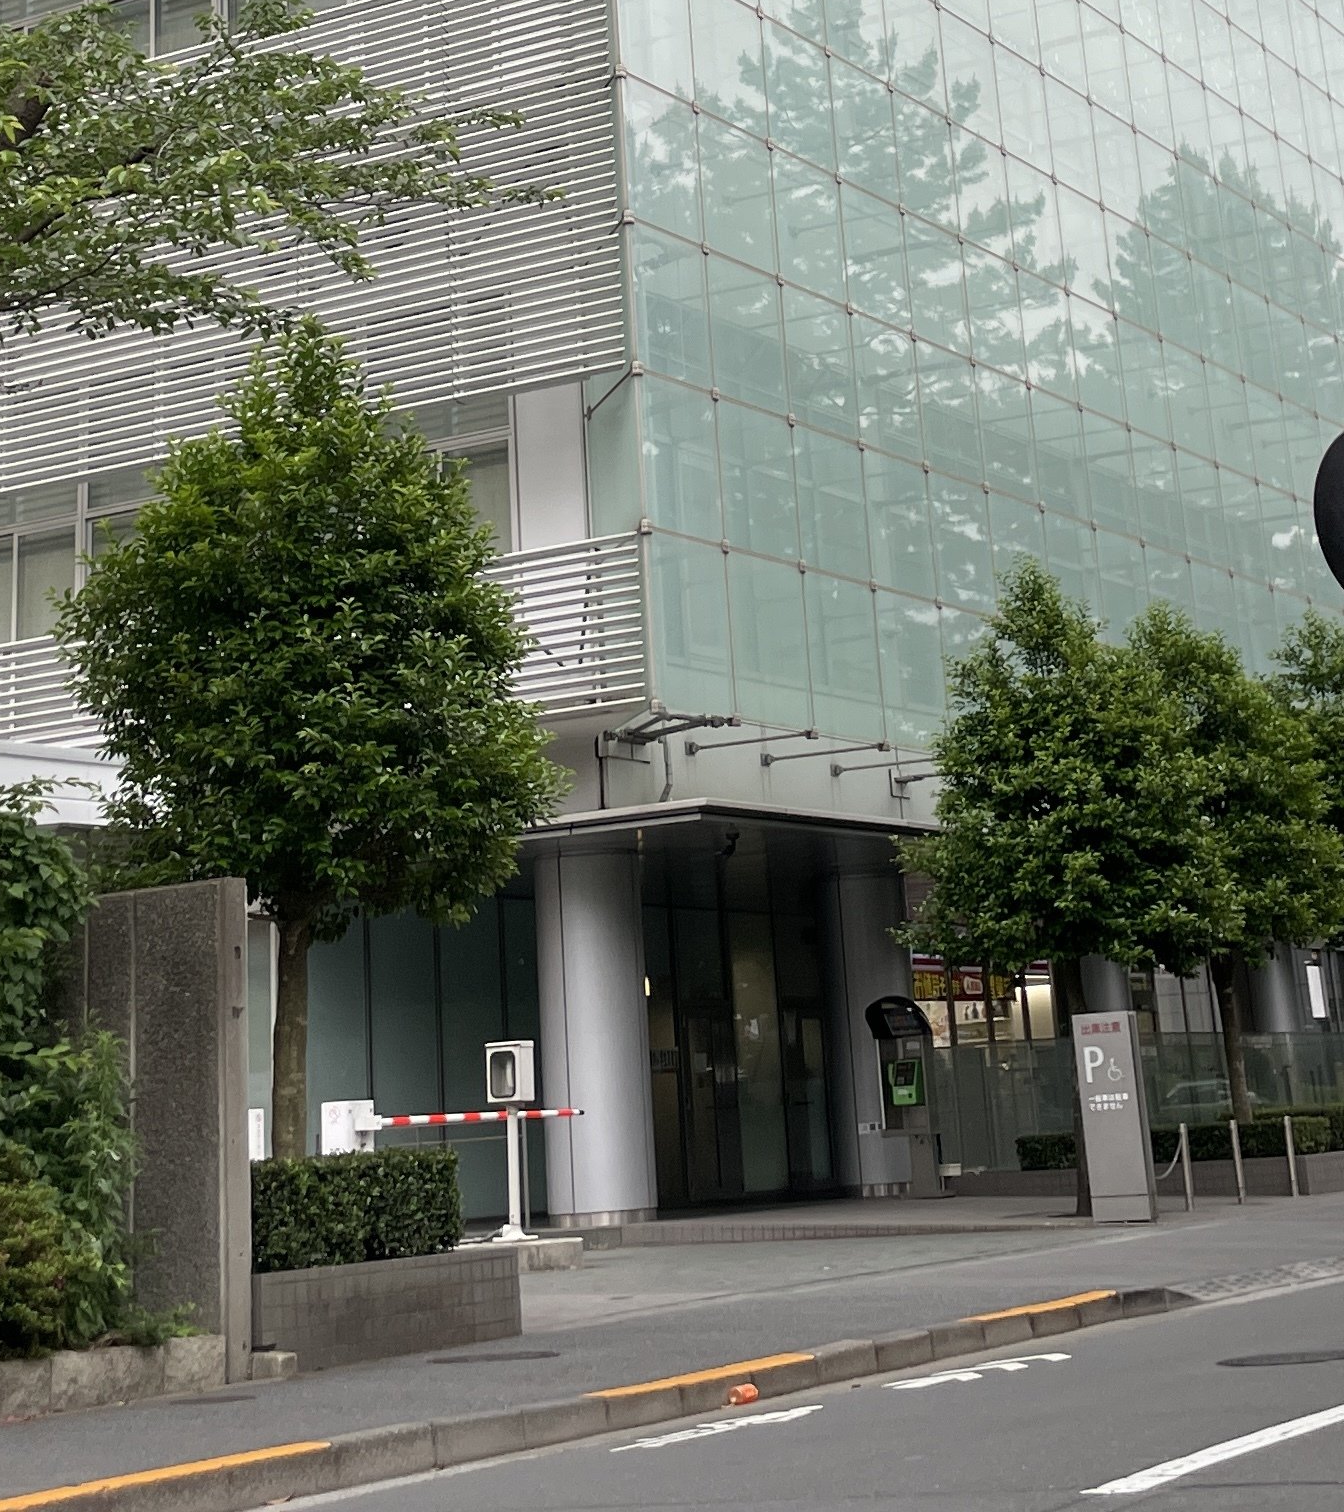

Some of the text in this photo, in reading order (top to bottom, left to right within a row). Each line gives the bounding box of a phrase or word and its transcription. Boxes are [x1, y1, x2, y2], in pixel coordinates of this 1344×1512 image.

[1080, 1021, 1121, 1035] 出庫注意
[1083, 1046, 1104, 1083] P
